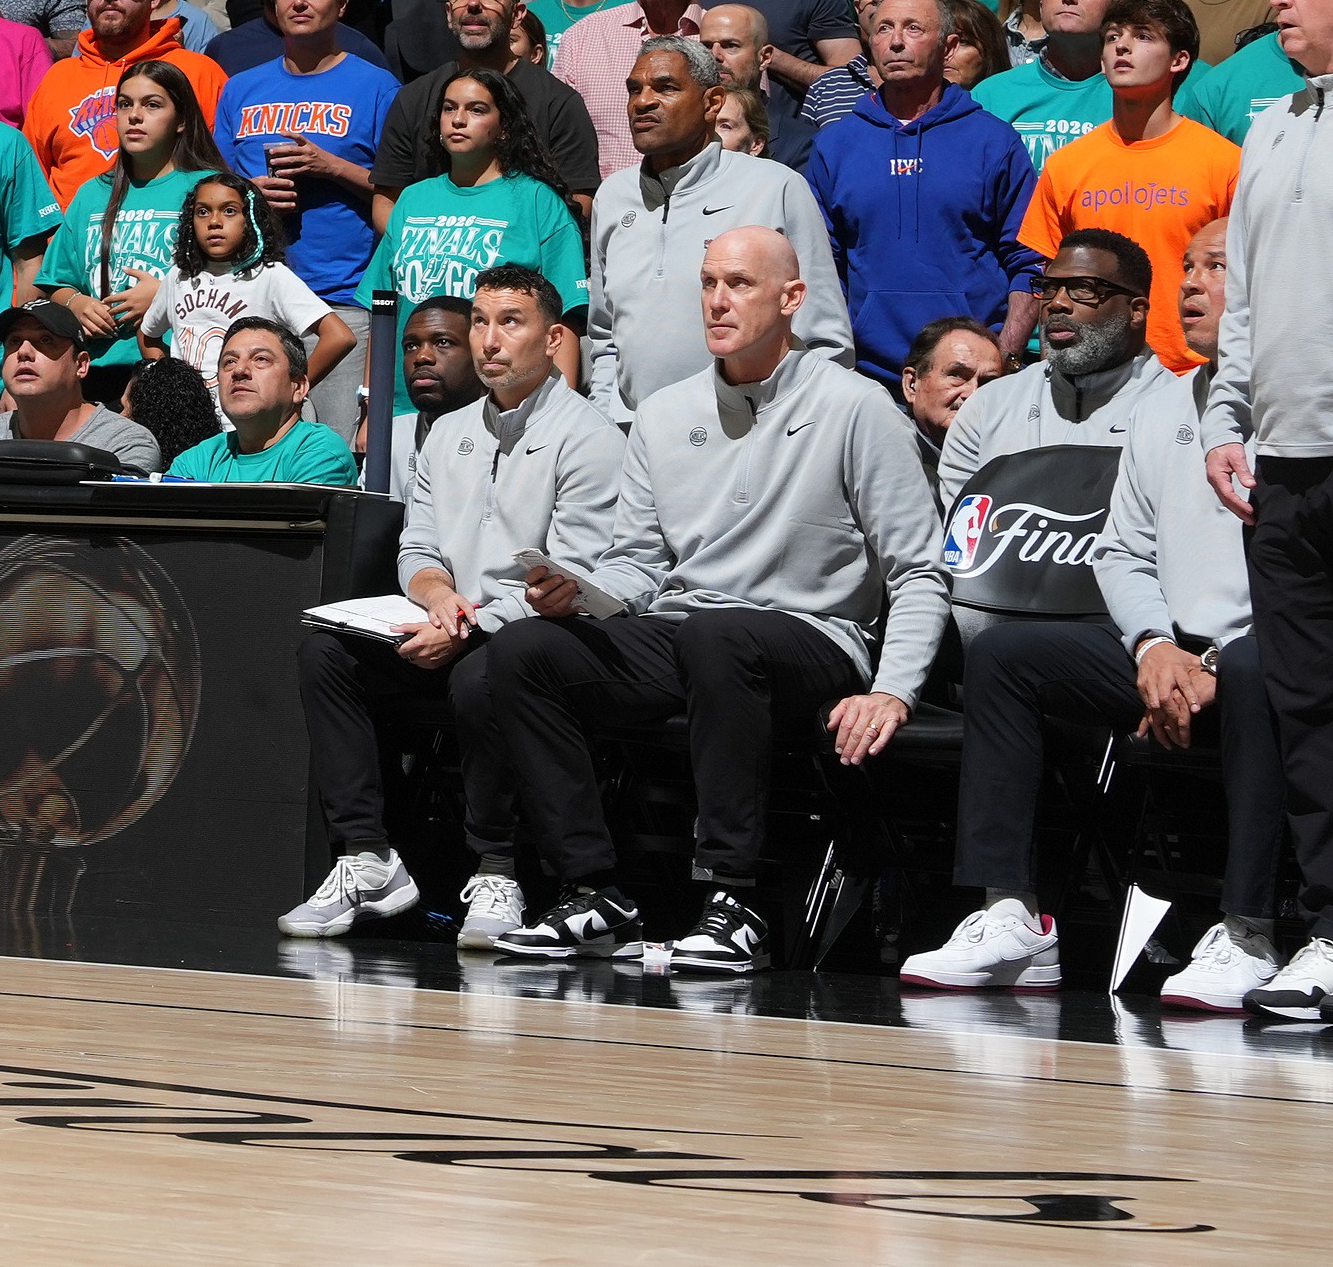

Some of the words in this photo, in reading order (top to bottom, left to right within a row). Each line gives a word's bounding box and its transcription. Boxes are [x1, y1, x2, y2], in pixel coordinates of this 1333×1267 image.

[235, 102, 352, 138] KNICKS
[1045, 120, 1091, 134] 2026
[1081, 181, 1189, 212] apolojets
[117, 209, 155, 222] 2026
[434, 215, 476, 227] 2026
[86, 221, 179, 265] FNALS
[393, 226, 505, 268] FINALS
[175, 288, 248, 321] SOCHAN
[957, 502, 1106, 578] Fina
